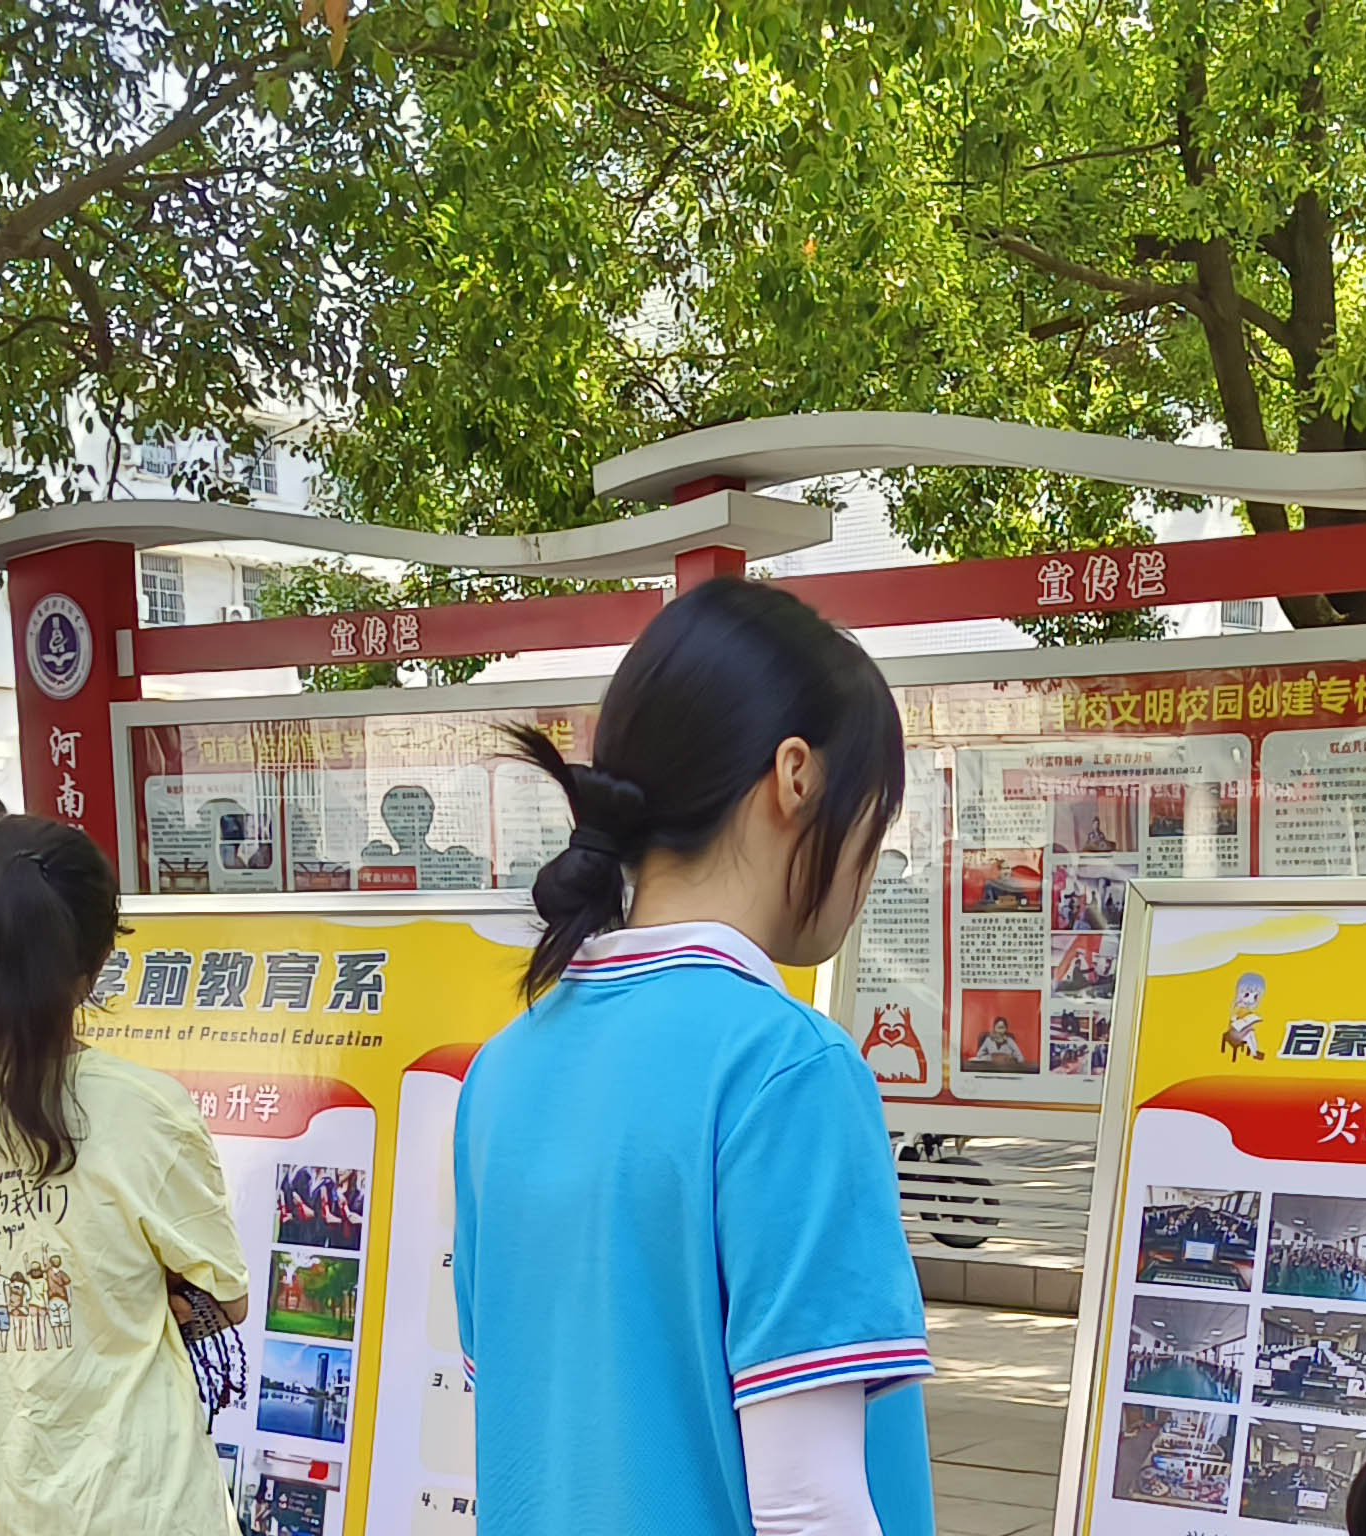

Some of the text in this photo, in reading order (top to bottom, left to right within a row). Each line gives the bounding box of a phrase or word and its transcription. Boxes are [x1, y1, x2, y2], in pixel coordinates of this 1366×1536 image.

[1037, 551, 1166, 606] 宣传栏
[331, 614, 419, 656] 宣传栏
[49, 726, 84, 829] 河南
[76, 1022, 383, 1047] Department of Preschool Education
